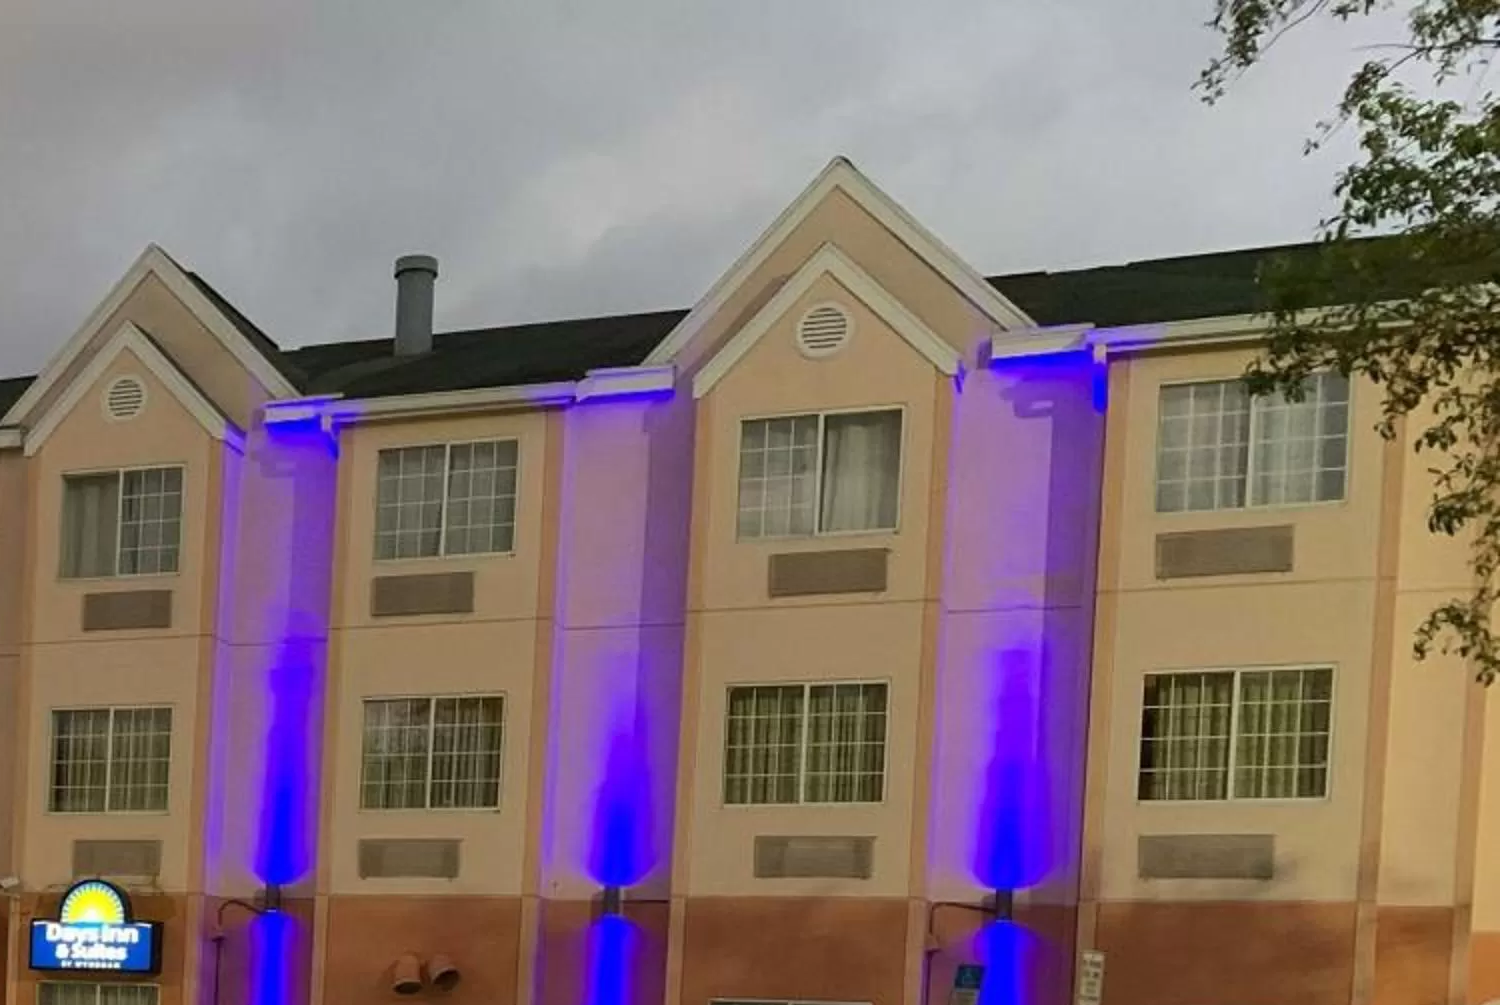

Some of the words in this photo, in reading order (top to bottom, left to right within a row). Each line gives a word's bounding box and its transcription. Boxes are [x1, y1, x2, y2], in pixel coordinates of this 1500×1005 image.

[46, 923, 98, 945] Days
[102, 923, 138, 943] Inn
[71, 943, 127, 960] Suites
